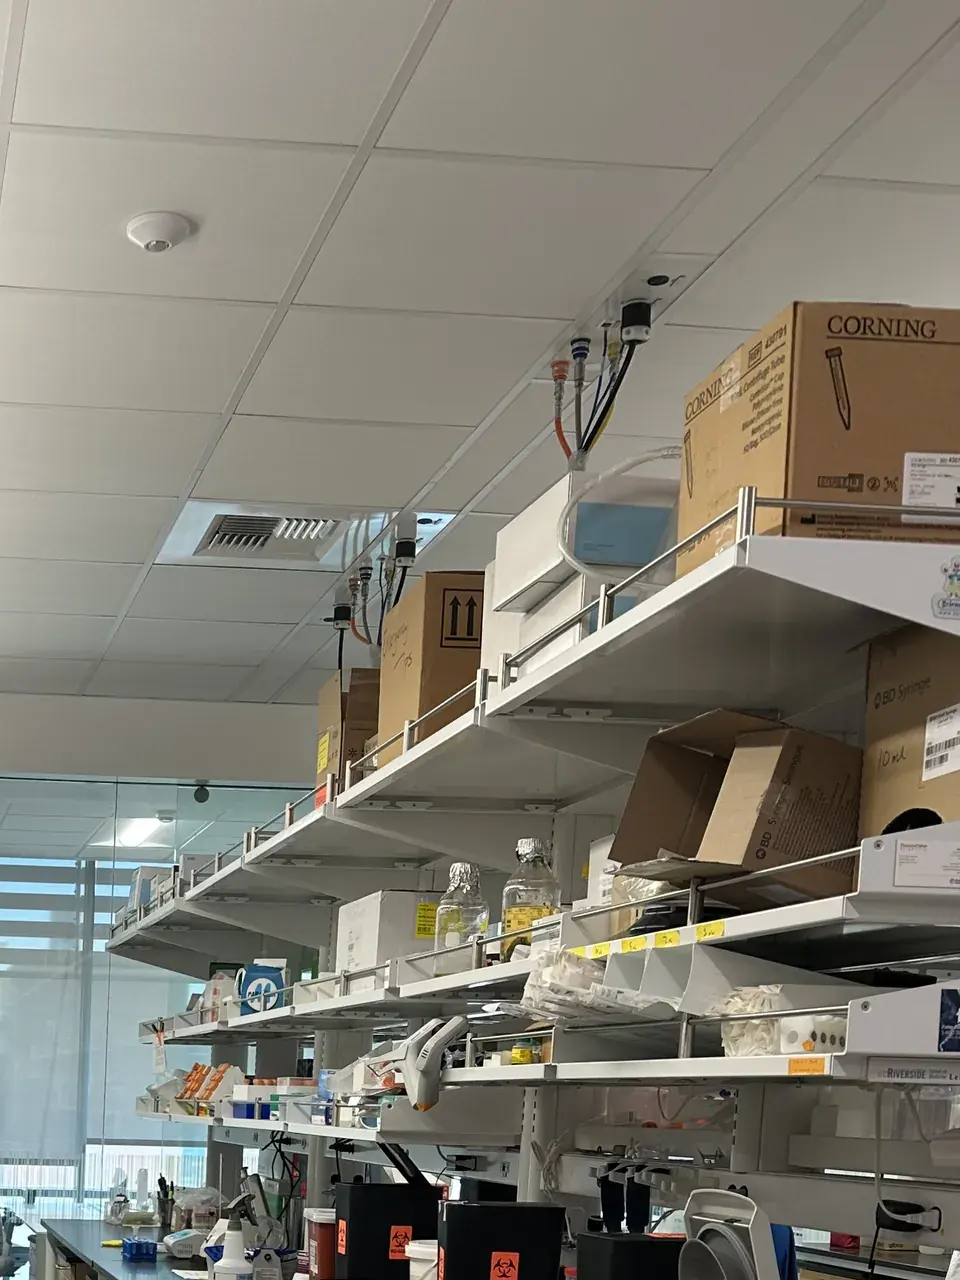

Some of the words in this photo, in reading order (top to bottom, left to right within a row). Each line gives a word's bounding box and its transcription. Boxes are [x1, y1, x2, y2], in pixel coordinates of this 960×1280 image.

[827, 314, 936, 339] CORNING
[882, 688, 896, 706] BD
[760, 831, 772, 849] BD
